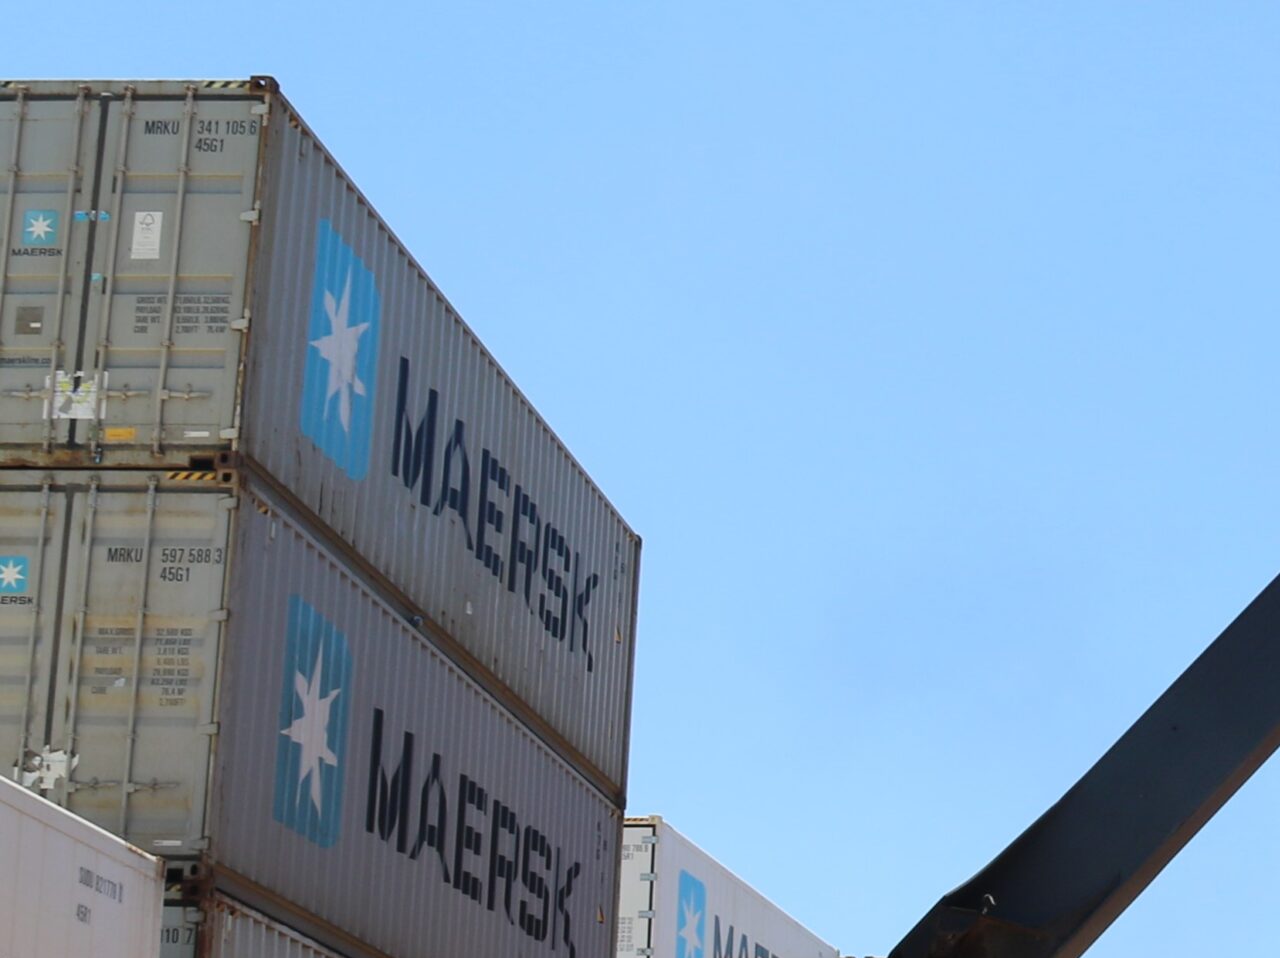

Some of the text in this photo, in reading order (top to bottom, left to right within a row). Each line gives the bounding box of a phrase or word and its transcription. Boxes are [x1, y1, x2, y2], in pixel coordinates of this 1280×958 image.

[144, 120, 257, 135] MRKU 341 105 6
[195, 138, 225, 152] 45G1
[11, 248, 63, 256] MAERSK
[391, 356, 599, 673] MAERSK
[107, 548, 222, 564] MRKU 597 588 3
[159, 567, 191, 582] 45G1
[0, 596, 34, 605] ERSK
